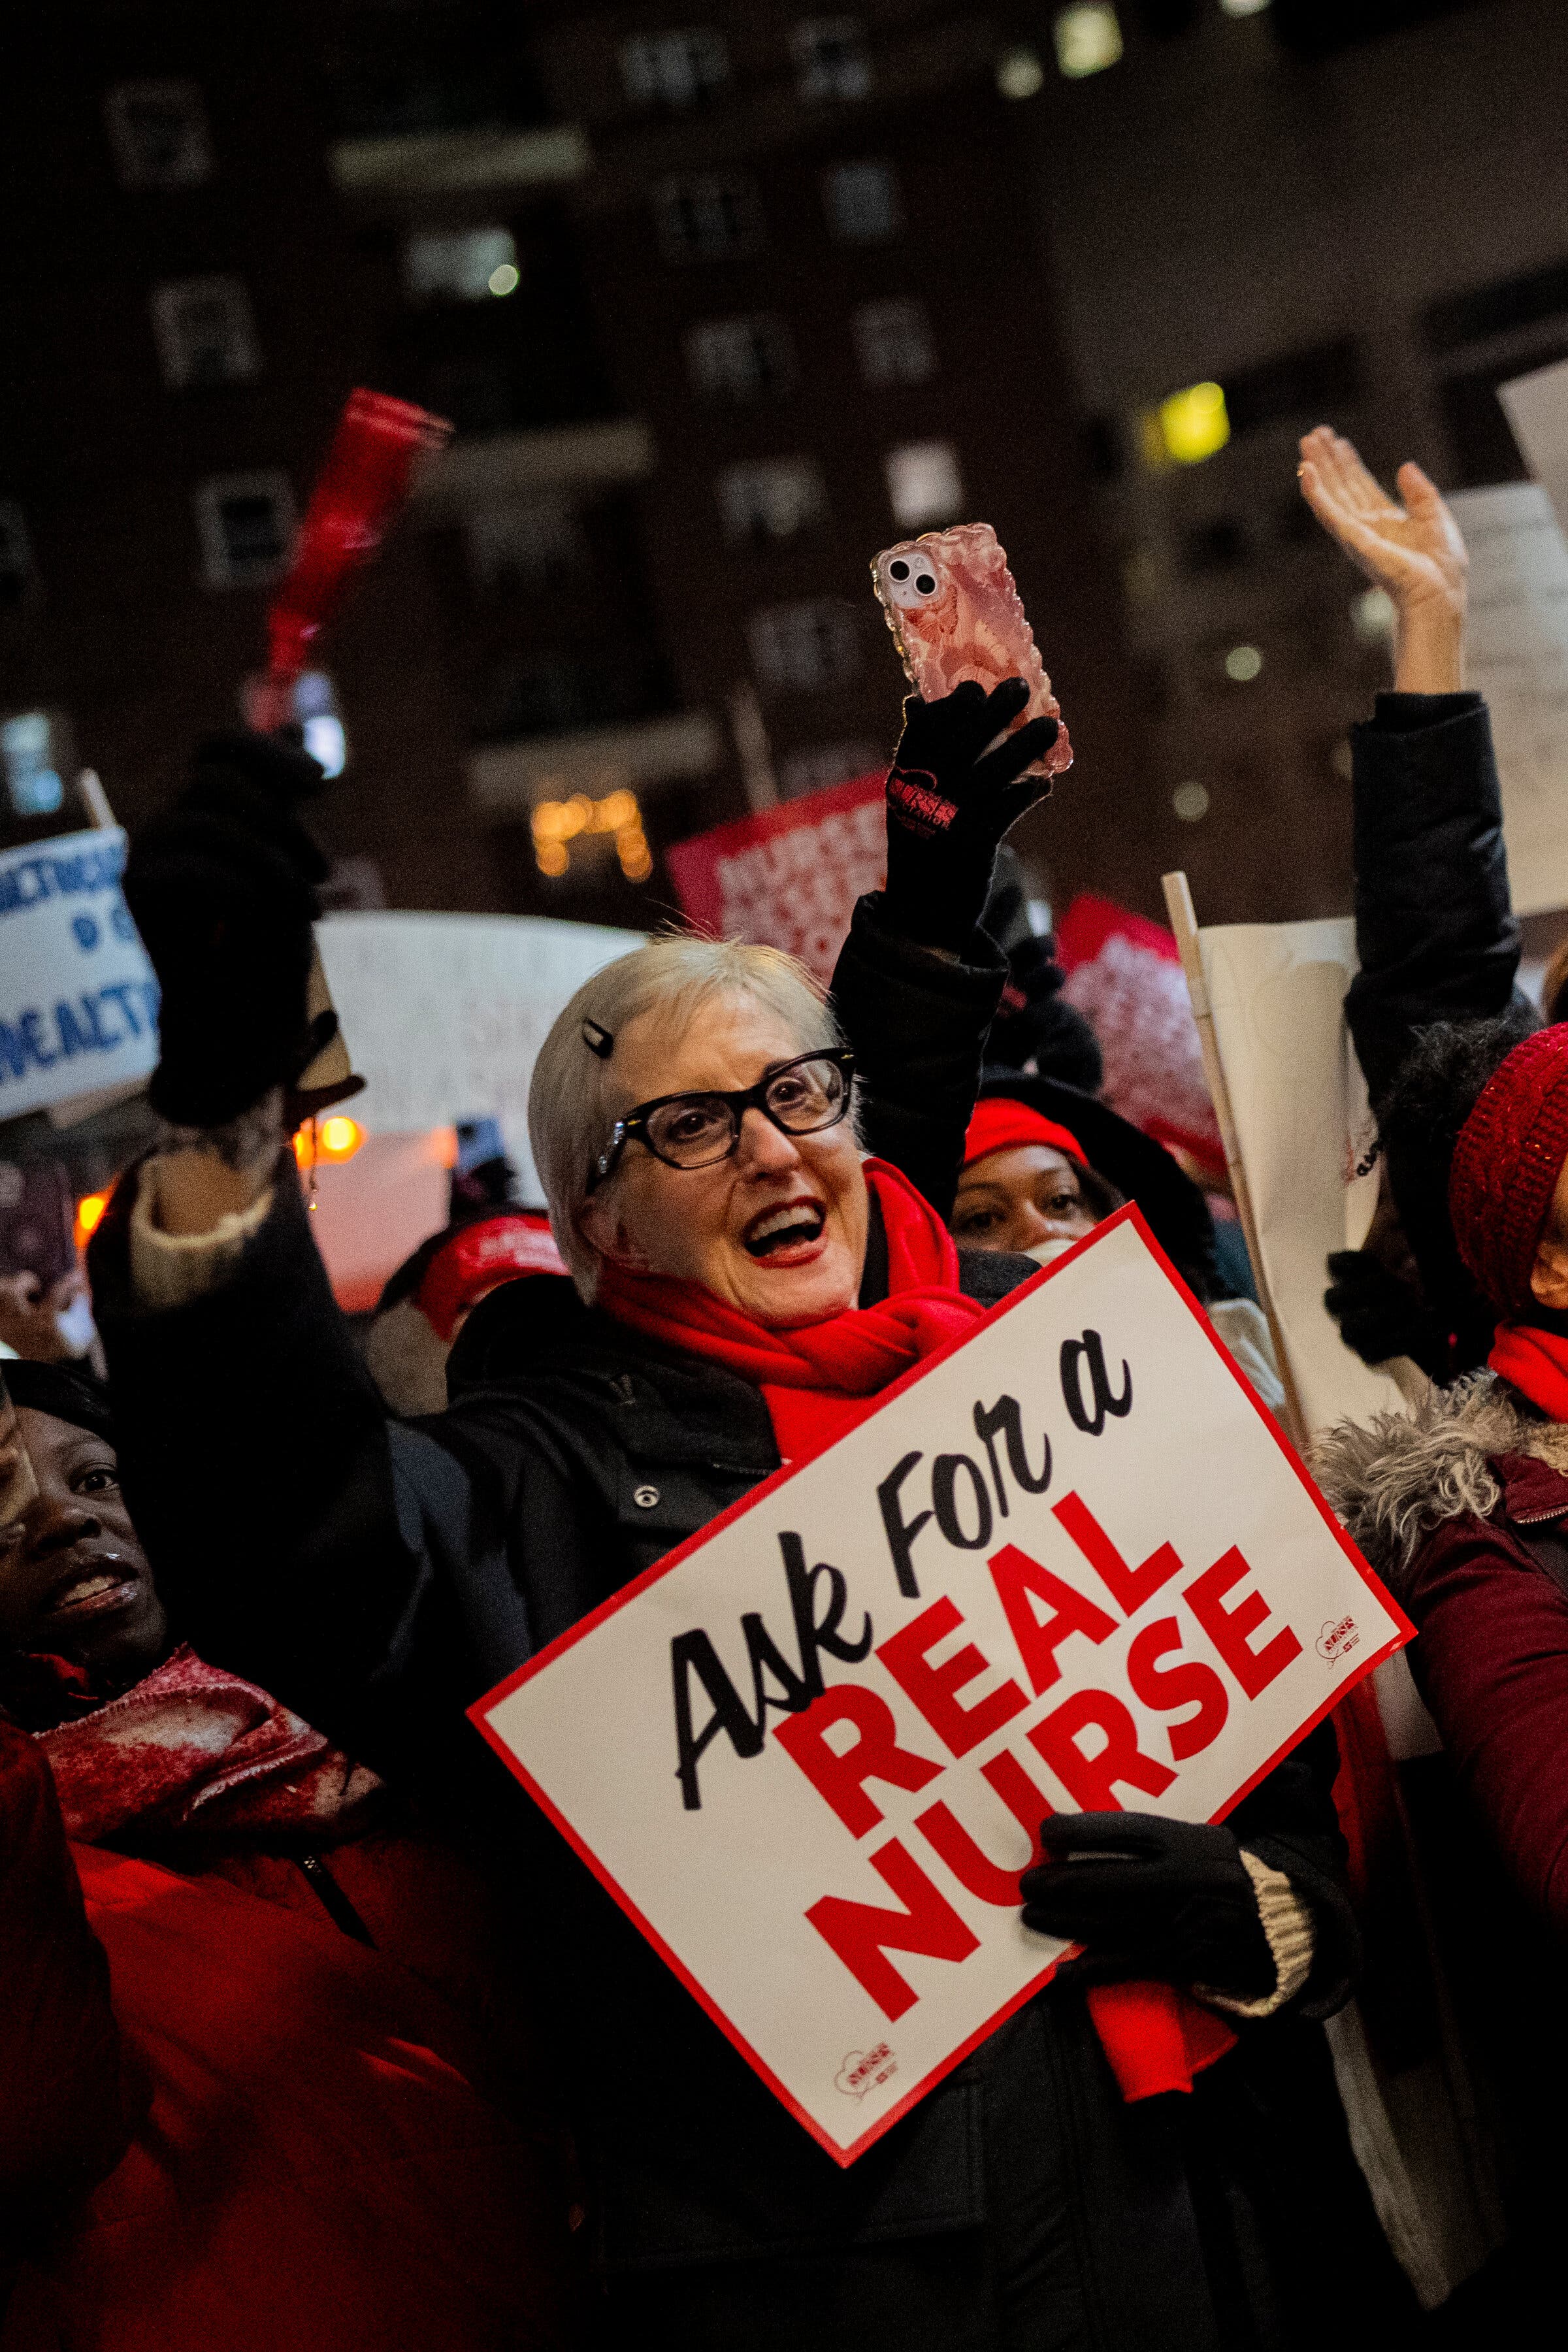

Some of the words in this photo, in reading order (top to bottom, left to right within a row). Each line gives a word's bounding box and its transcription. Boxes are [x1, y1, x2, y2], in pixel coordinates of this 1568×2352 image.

[672, 1531, 873, 1811] Ask
[877, 1396, 1052, 1598] For
[1060, 1329, 1132, 1436] a
[772, 1490, 1184, 1840] REAL
[1324, 1618, 1355, 1651] NURSES
[804, 1544, 1303, 2023] NURSE
